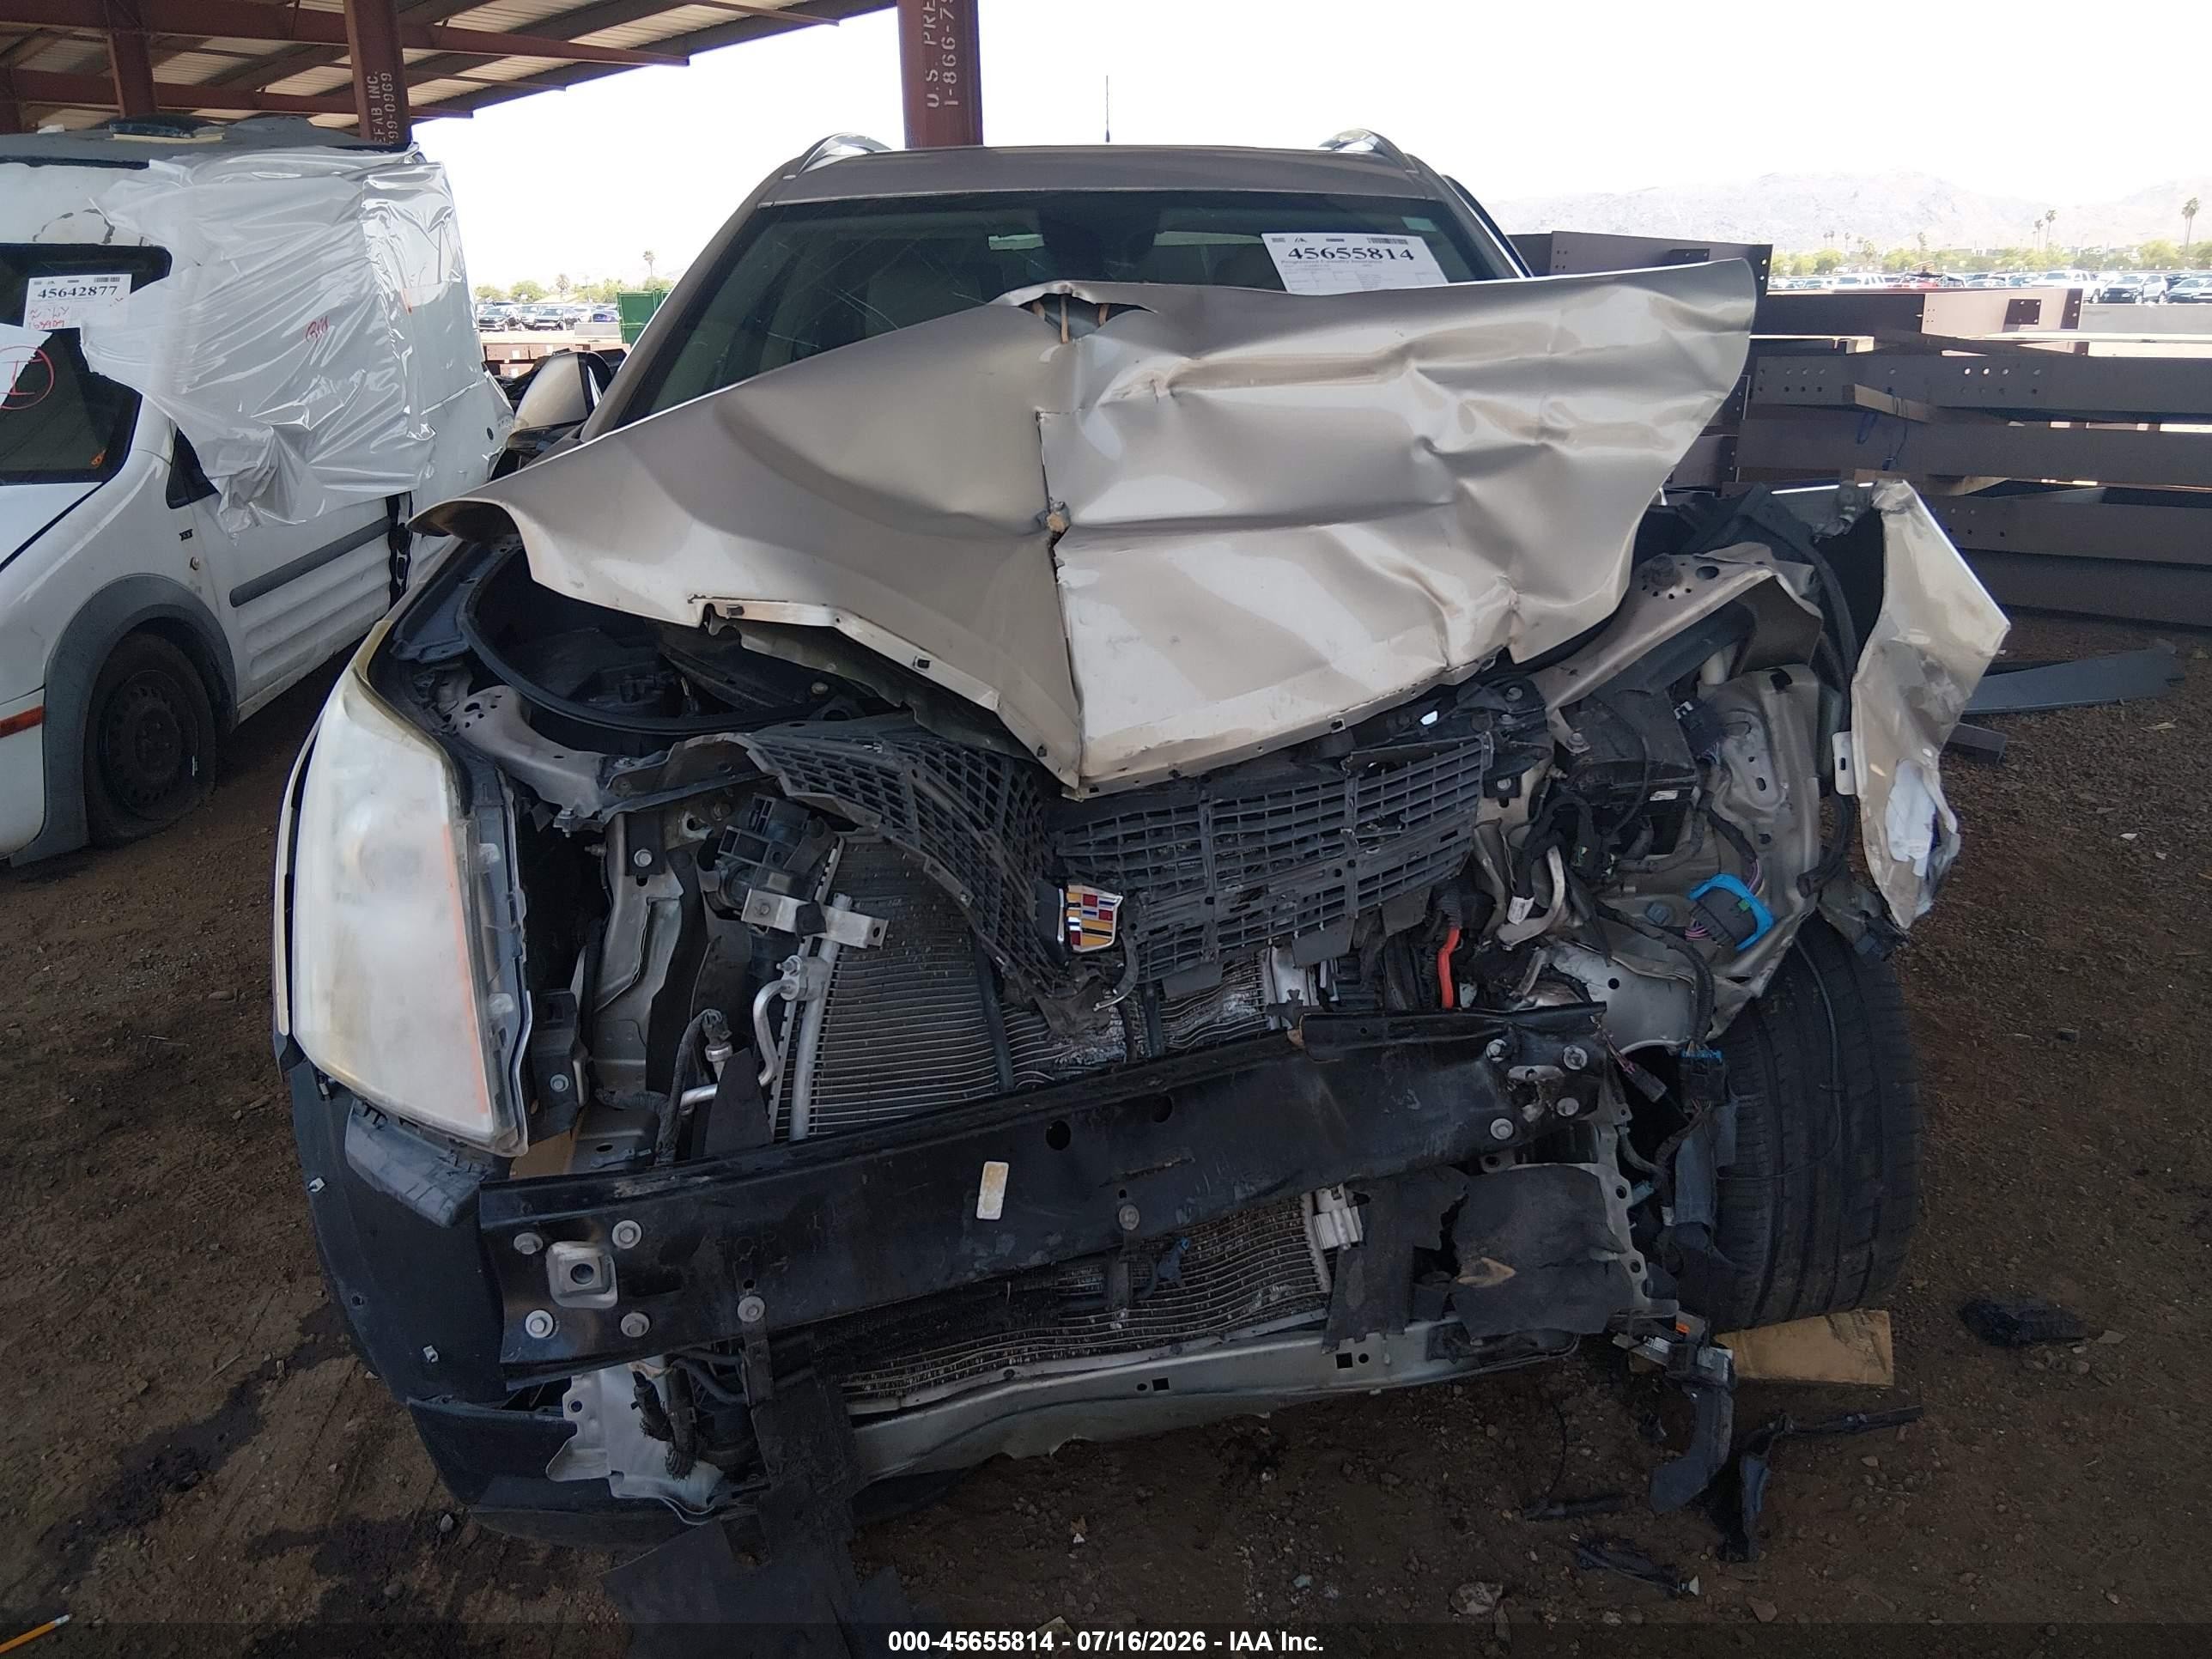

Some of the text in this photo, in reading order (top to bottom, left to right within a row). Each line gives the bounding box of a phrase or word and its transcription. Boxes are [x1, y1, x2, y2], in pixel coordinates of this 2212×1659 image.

[939, 0, 959, 106] 1-866-7
[367, 71, 380, 99] INC.
[1288, 246, 1415, 261] 45655814
[38, 285, 118, 299] 45642877
